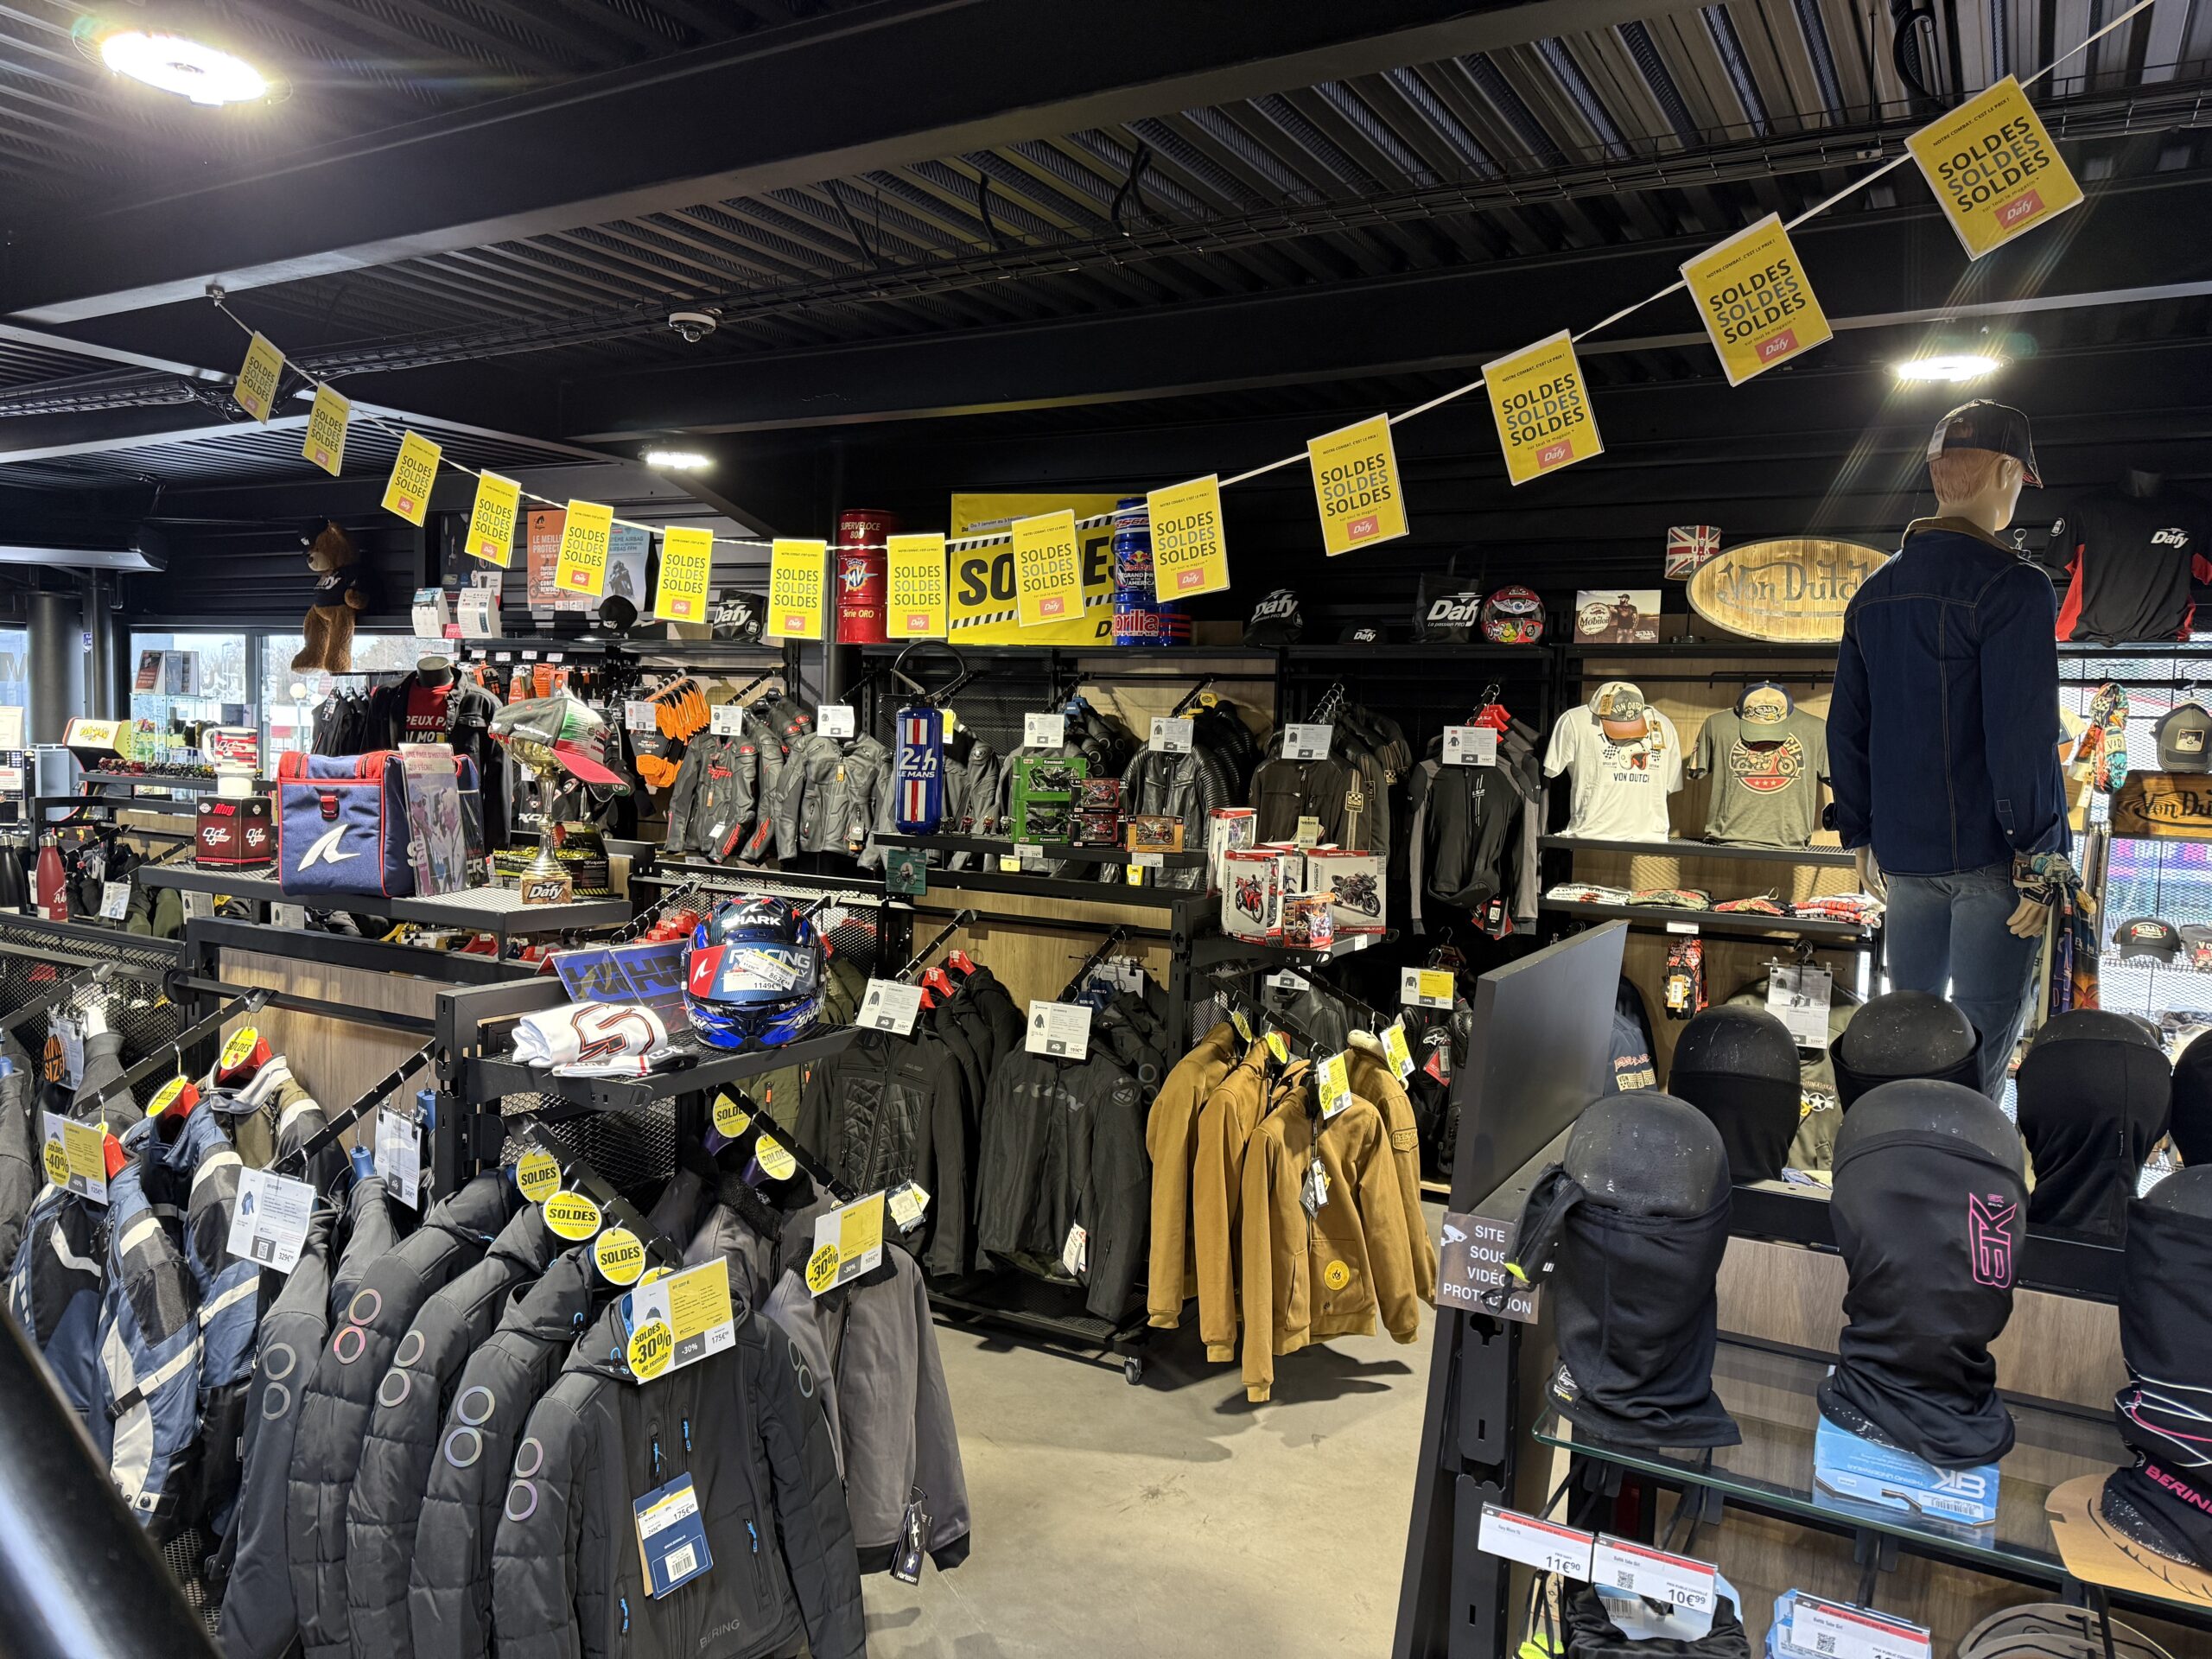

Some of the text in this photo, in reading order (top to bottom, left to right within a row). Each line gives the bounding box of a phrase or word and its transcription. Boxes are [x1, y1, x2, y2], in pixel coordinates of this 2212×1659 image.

[1937, 116, 2031, 181] SOLDES
[1948, 133, 2040, 197] SOLDES
[1957, 149, 2050, 213] SOLDES
[2006, 200, 2032, 221] Dafy
[1709, 259, 1791, 312] SOLDES
[1717, 276, 1799, 327] SOLDES
[1724, 292, 1806, 344] SOLDES
[1765, 338, 1789, 356] Dafy
[248, 356, 275, 383] SOLDES
[242, 376, 270, 402] SOLDES
[1502, 373, 1575, 414] SOLDES
[315, 408, 343, 432] SOLDES
[1506, 391, 1580, 430] SOLDES
[313, 418, 340, 442] SOLDES
[1510, 406, 1585, 447] SOLDES
[310, 429, 339, 453] SOLDES
[1544, 448, 1566, 462] Dafy
[402, 455, 432, 478] SOLDES
[1320, 454, 1386, 486] SOLDES
[395, 476, 426, 499] SOLDES
[398, 467, 429, 488] SOLDES
[1323, 470, 1389, 501] SOLDES
[479, 499, 512, 519] SOLDES
[1325, 486, 1391, 517] SOLDES
[477, 511, 510, 531] SOLDES
[841, 522, 880, 531] SUPERVELOCE
[1157, 512, 1214, 537] SOLDES
[1353, 522, 1372, 534] Dafy
[474, 522, 508, 543] SOLDES
[569, 527, 605, 543] SOLDES
[1159, 526, 1215, 551] SOLDES
[2151, 531, 2189, 549] Dafy
[533, 543, 561, 553] PROTECT
[567, 538, 604, 555] SOLDES
[1020, 543, 1071, 563] SOLDES
[1160, 541, 1217, 566] SOLDES
[564, 550, 602, 567] SOLDES
[666, 554, 705, 569] SOLDES
[1022, 557, 1073, 578] SOLDES
[664, 566, 704, 581] SOLDES
[776, 569, 818, 582] SOLDES
[894, 566, 940, 578] SOLDES
[1182, 575, 1198, 585] Dafy
[663, 579, 702, 594] SOLDES
[775, 582, 817, 594] SOLDES
[894, 579, 941, 593] SOLDES
[1024, 572, 1075, 593] SOLDES
[1717, 560, 1777, 606] Von
[774, 594, 817, 608] SOLDES
[894, 593, 941, 606] SOLDES
[1045, 603, 1059, 612] Dafy
[1252, 594, 1298, 622] Dafy
[715, 604, 753, 626] Dafy
[858, 610, 874, 619] ORO
[1112, 609, 1160, 633] prilia
[1353, 632, 1376, 642] Dafy
[1611, 702, 1626, 714] VON
[900, 747, 938, 771] 24h
[1613, 772, 1628, 782] VON
[213, 804, 236, 817] Mug
[528, 882, 564, 900] Dafy
[226, 1040, 251, 1053] SOLDES
[716, 1106, 743, 1122] SOLDE
[48, 1143, 64, 1154] SOLDES
[45, 1154, 69, 1173] -40%
[520, 1166, 557, 1186] SOLDES
[548, 1207, 597, 1222] SOLDES
[1475, 1225, 1505, 1243] SITE
[600, 1245, 641, 1265] SOLDES
[811, 1245, 831, 1266] SOLDES
[808, 1252, 839, 1284] -30%
[1443, 1283, 1531, 1314] PROTCION
[634, 1322, 661, 1345] SOLDES
[631, 1332, 671, 1365] -30%
[681, 1343, 698, 1356] -30%
[640, 1351, 669, 1374] de remise
[2145, 1465, 2212, 1514] BERIN
[1546, 1555, 1580, 1573] 11€90
[1669, 1589, 1706, 1607] 10€99
[699, 1618, 741, 1649] BERING
